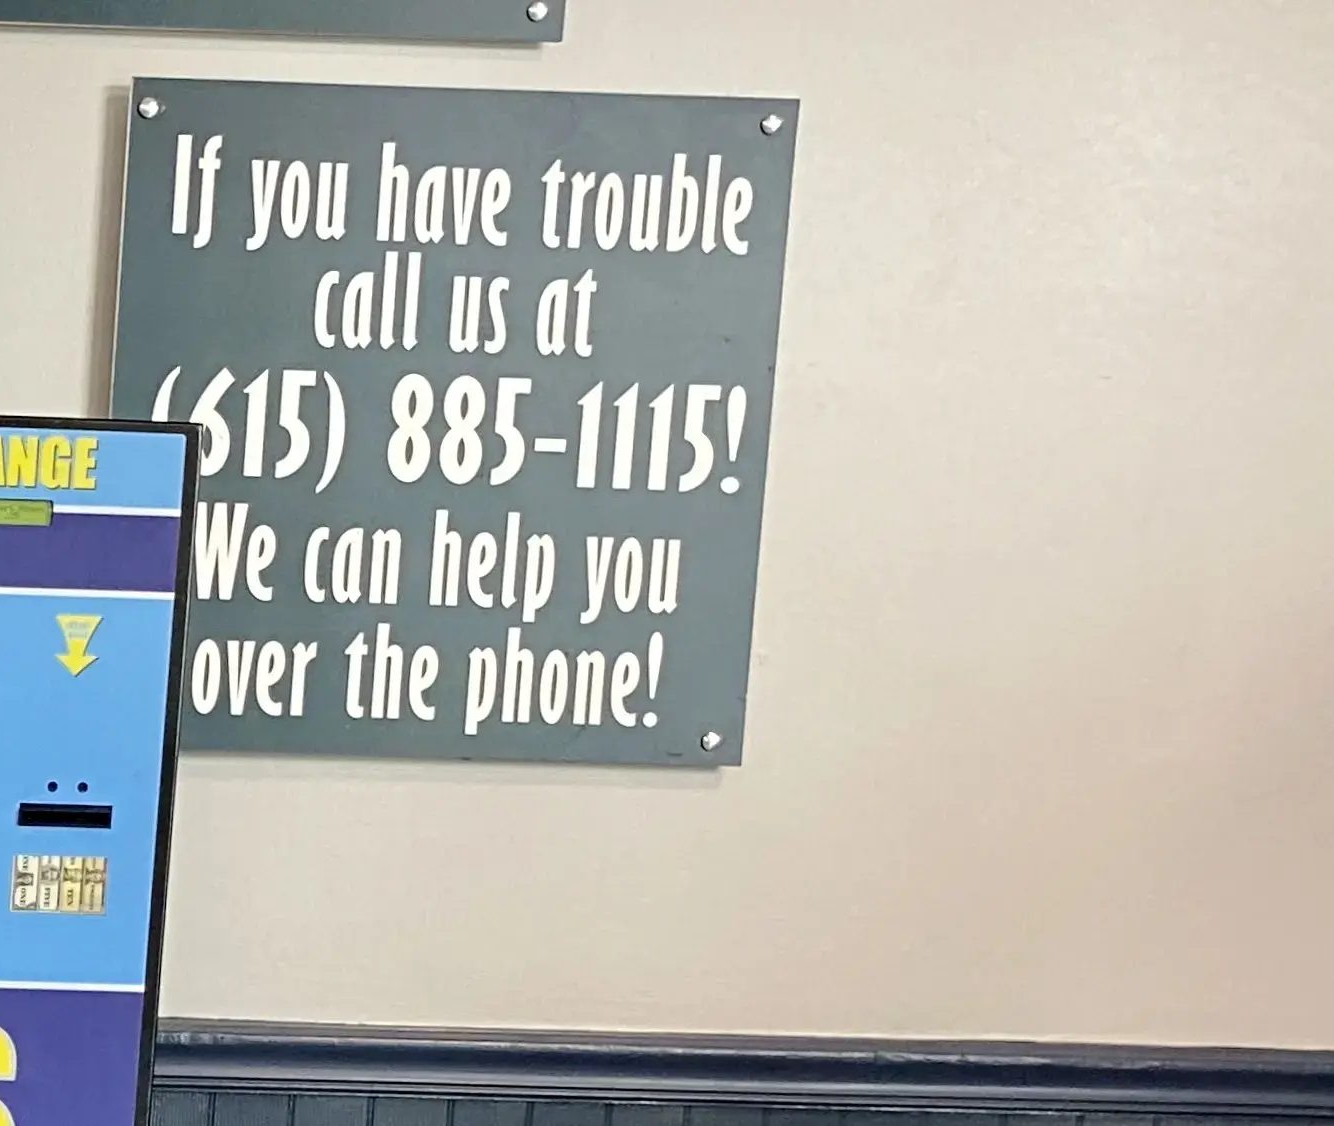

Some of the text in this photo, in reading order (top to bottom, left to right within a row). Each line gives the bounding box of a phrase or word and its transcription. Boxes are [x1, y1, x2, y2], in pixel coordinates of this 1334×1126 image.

[170, 133, 754, 256] If you have trouble
[314, 250, 598, 358] call us at
[387, 373, 747, 494] 885-1115!
[194, 501, 681, 625] We can help you
[191, 622, 664, 735] over the phone!
